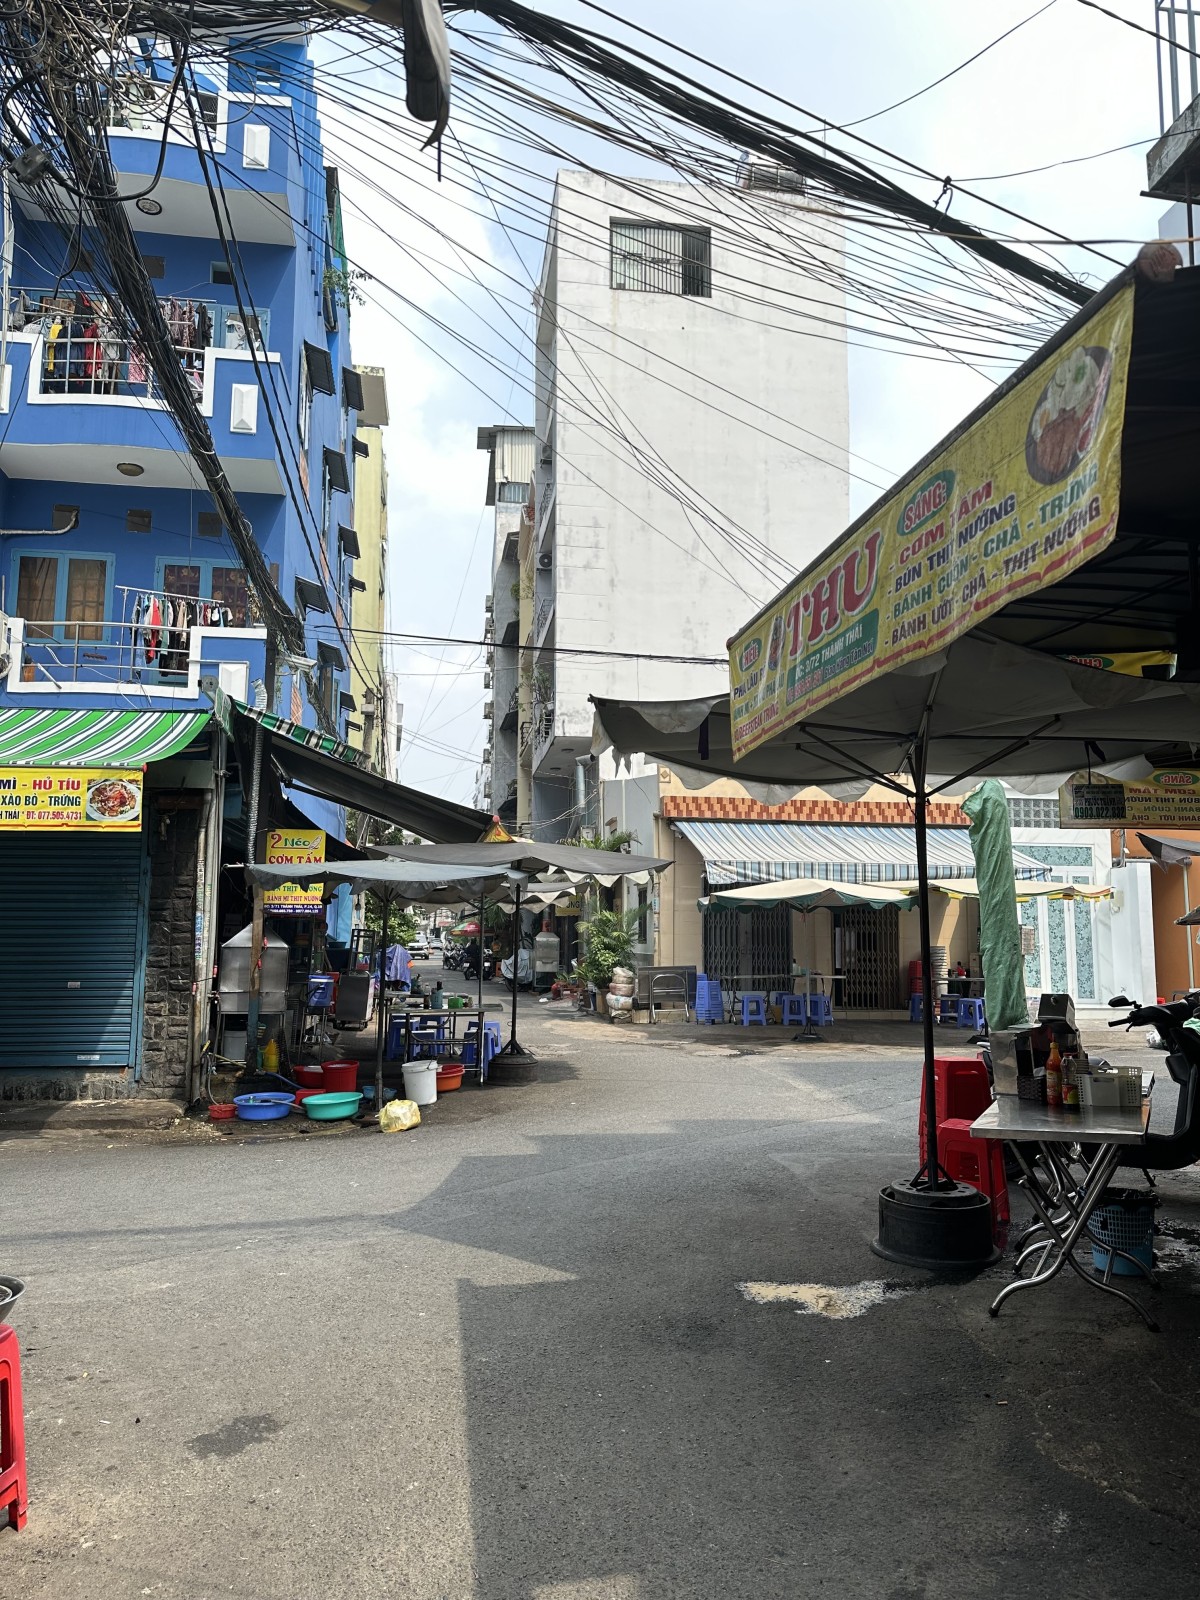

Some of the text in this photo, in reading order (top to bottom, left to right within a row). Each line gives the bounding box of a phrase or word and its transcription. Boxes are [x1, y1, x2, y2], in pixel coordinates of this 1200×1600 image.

[904, 480, 947, 532] SÁNG:
[893, 583, 932, 620] BÁNH
[983, 517, 1021, 559] CHẢ
[1039, 461, 1098, 524] TRỨNG
[895, 561, 922, 593] BÚN
[958, 493, 1016, 548] NƯỚNG
[899, 521, 945, 566] CƠM
[786, 531, 882, 658] THU
[891, 612, 927, 646] BÁNH
[962, 565, 987, 603] CHẢ
[1003, 541, 1039, 577] THỊT
[1043, 495, 1100, 556] NƯỚNG
[1, 793, 21, 806] XÀO
[24, 793, 38, 806] BÒ
[48, 794, 82, 807] TRỨNG
[32, 776, 53, 790] HỦ
[57, 777, 81, 791] TÍU
[268, 852, 322, 864] CƠM TẤM
